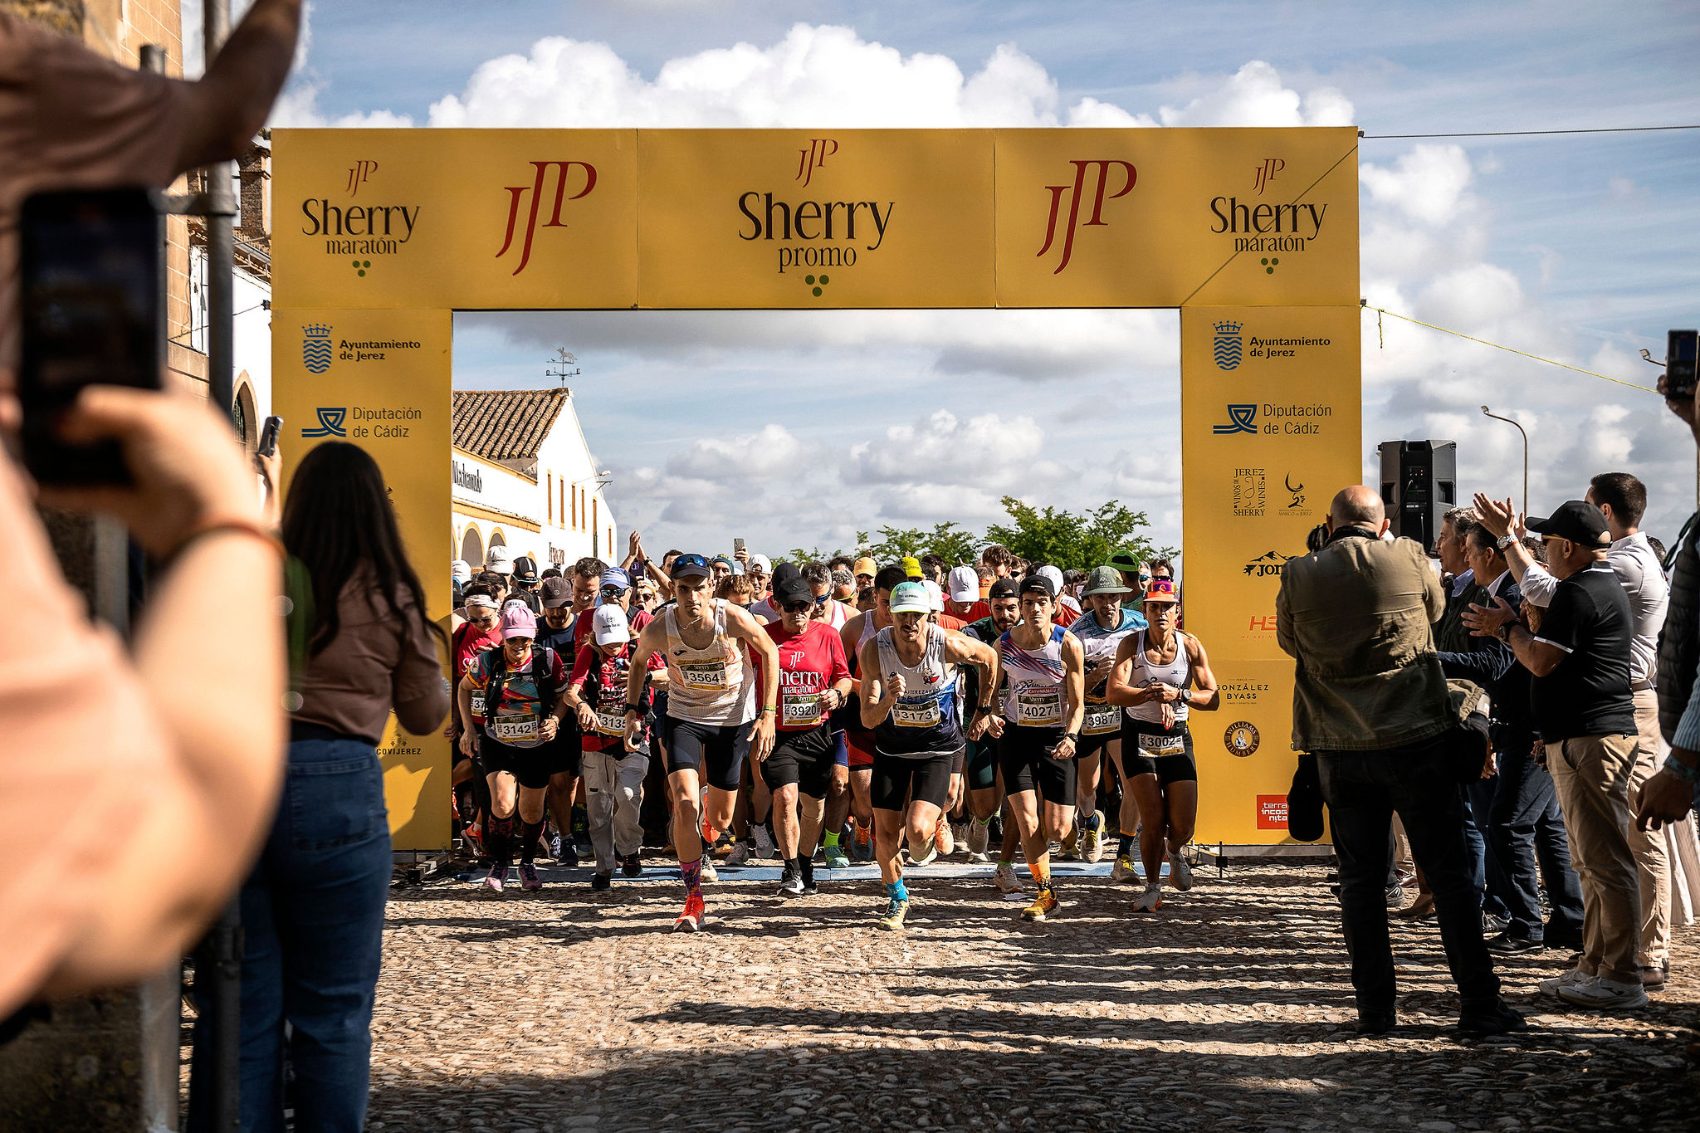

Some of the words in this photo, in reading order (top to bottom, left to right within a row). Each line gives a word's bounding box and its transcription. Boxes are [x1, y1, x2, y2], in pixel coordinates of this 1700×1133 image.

[301, 198, 420, 243] Sherry
[738, 192, 896, 251] Sherry
[1210, 197, 1329, 241] Sherry
[326, 236, 398, 255] maratón
[1234, 234, 1305, 252] maratón
[778, 246, 857, 274] promo
[339, 339, 421, 352] Ayuntamiento
[1250, 336, 1331, 349] Ayuntamiento
[339, 351, 354, 361] de
[356, 351, 386, 362] Jerez
[1250, 348, 1264, 358] de
[1266, 348, 1296, 359] Jerez
[352, 406, 422, 422] Diputación
[1263, 402, 1332, 418] Diputación
[353, 425, 370, 438] de
[373, 424, 409, 438] Cádiz
[1263, 422, 1279, 435] de
[1284, 421, 1320, 435] Cádiz
[1235, 468, 1265, 477] JEREZ
[1233, 485, 1241, 505] VINOS
[1258, 480, 1266, 508] WINES
[1233, 509, 1266, 517] SHERRY
[690, 672, 719, 682] 3564
[779, 669, 823, 689] herry
[791, 706, 817, 716] 3920
[901, 711, 932, 720] 3173
[1025, 706, 1053, 717] 4027
[1088, 715, 1115, 726] 3987
[504, 725, 531, 734] 3142
[1227, 722, 1257, 735] WILLIAMS
[1148, 737, 1175, 747] 3002
[1269, 815, 1288, 823] nita
